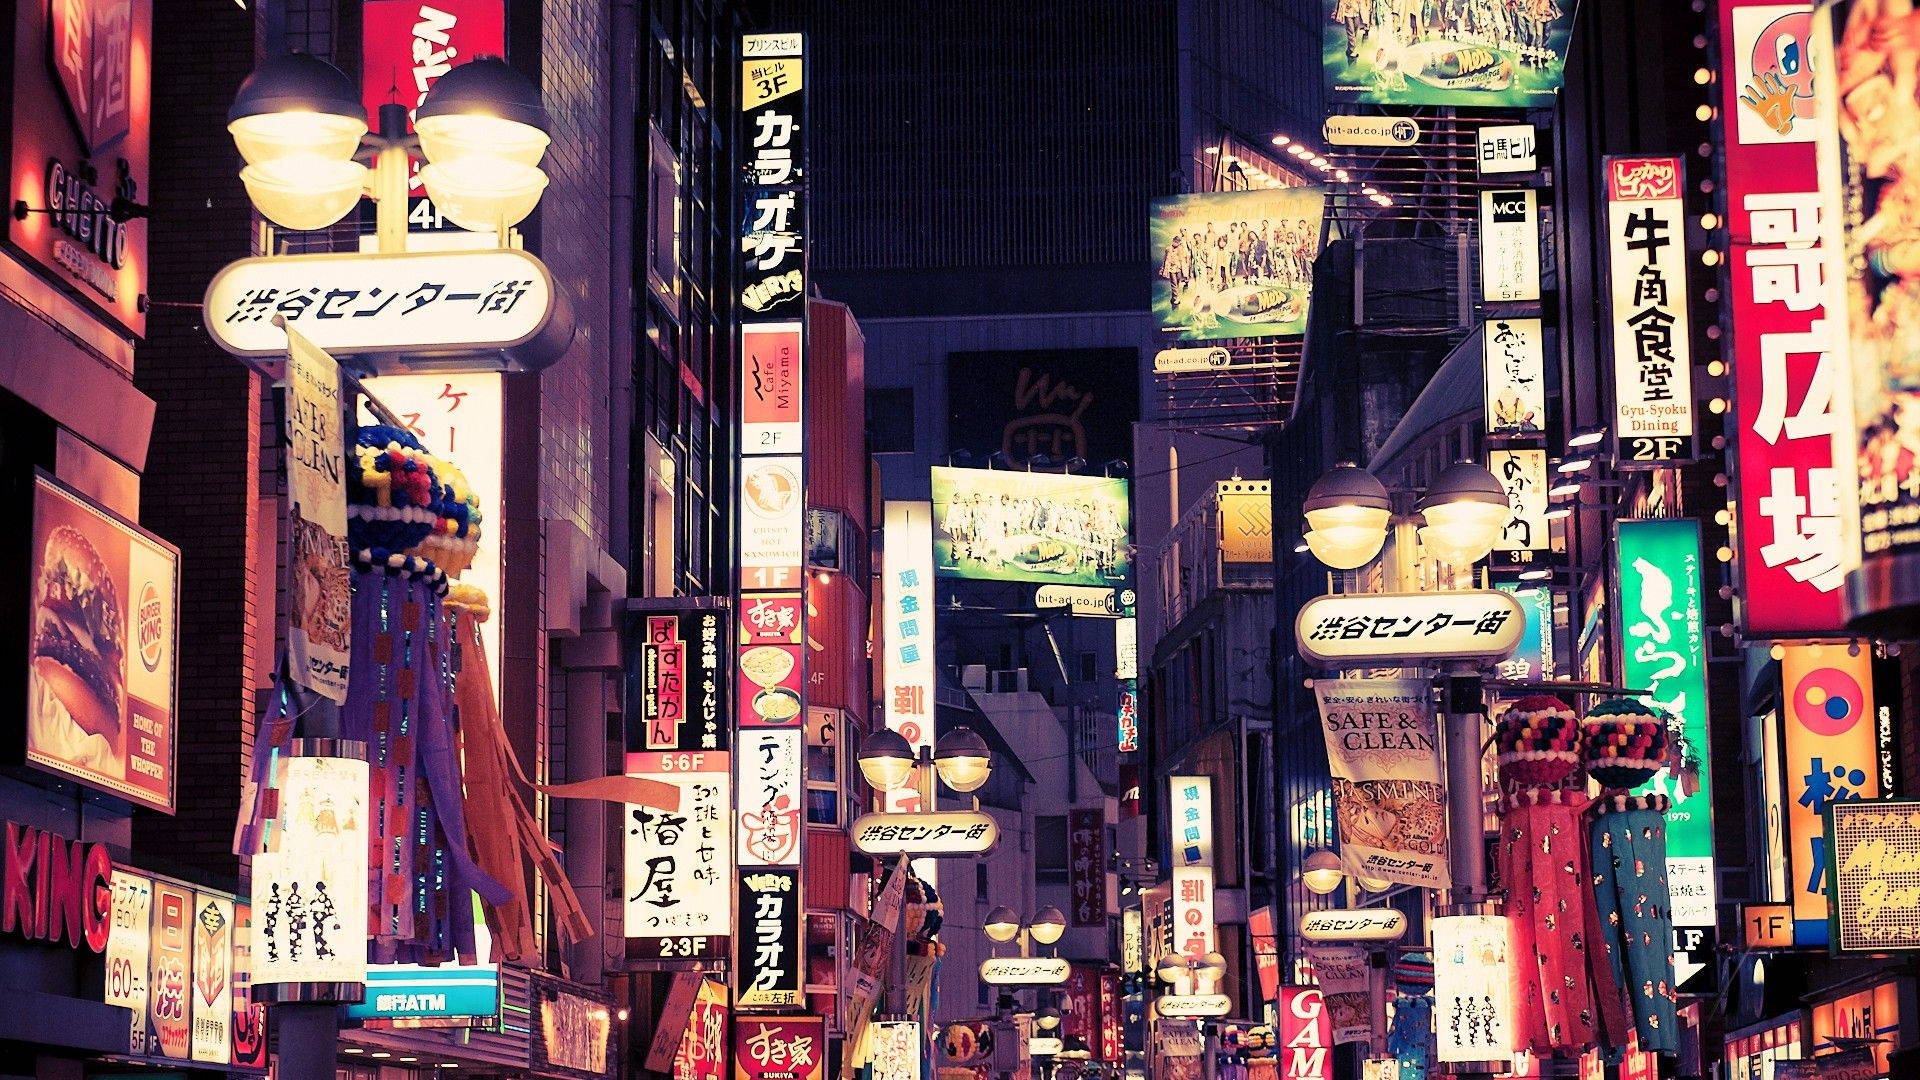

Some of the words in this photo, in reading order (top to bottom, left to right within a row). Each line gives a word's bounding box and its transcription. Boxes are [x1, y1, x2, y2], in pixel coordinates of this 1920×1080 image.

[747, 39, 798, 52] プリンスビル
[751, 61, 785, 81] 当ビル
[756, 74, 788, 99] 3F
[1327, 125, 1391, 137] hit-ad.co.jp
[1482, 136, 1536, 159] 白馬ビル
[753, 109, 800, 271] カラオケ
[1493, 201, 1526, 215] MCC
[225, 280, 534, 325] 渋谷センター街
[1502, 291, 1523, 299] 5F
[1623, 207, 1676, 402] 牛角食堂
[1157, 356, 1208, 366] hit-ad.co.jp
[764, 361, 775, 393] Cafe
[777, 346, 792, 410] Miyama
[1621, 404, 1688, 418] Gyu-Syoku
[1631, 419, 1680, 433] Dining
[760, 430, 783, 446] 2F
[1632, 437, 1683, 461] 2F
[761, 538, 781, 546] HOT
[744, 550, 800, 559] SANDWICH
[754, 567, 790, 588] 1F
[1038, 593, 1104, 609] hit-ad.co.jp
[140, 600, 161, 625] BURGER
[748, 598, 796, 632] すき家
[898, 568, 921, 665] 現金問屋
[140, 621, 162, 645] KING
[1310, 609, 1512, 641] 渋谷センター街
[650, 621, 681, 744] ぱすたかん
[133, 713, 154, 735] HOME
[154, 719, 164, 738] OF
[1326, 712, 1393, 732] SAFE
[1398, 713, 1418, 730] &
[140, 736, 156, 756] THE
[1343, 731, 1436, 752] CLEAN
[131, 754, 164, 781] WHOPPER
[758, 735, 789, 809] テング
[1337, 778, 1443, 804] JASMINE
[1667, 812, 1691, 822] 1979
[859, 822, 991, 841] 渋谷センター街
[630, 806, 689, 908] 椿屋
[1366, 854, 1434, 873] 渋谷センター街
[1668, 863, 1708, 875] ステーキ
[3, 820, 113, 953] KING
[116, 908, 137, 930] BOX
[646, 913, 709, 928] つばきや
[1305, 916, 1400, 932] 渋谷センター街
[1752, 915, 1785, 939] 1F
[754, 893, 785, 991] カラオケ
[1672, 929, 1704, 951] 1F
[986, 965, 1065, 976] 渋谷センター街
[132, 1030, 145, 1050] 5F
[1287, 989, 1328, 1080] GAM
[746, 1022, 813, 1072] すき家
[763, 1072, 794, 1080] SUKIYA
